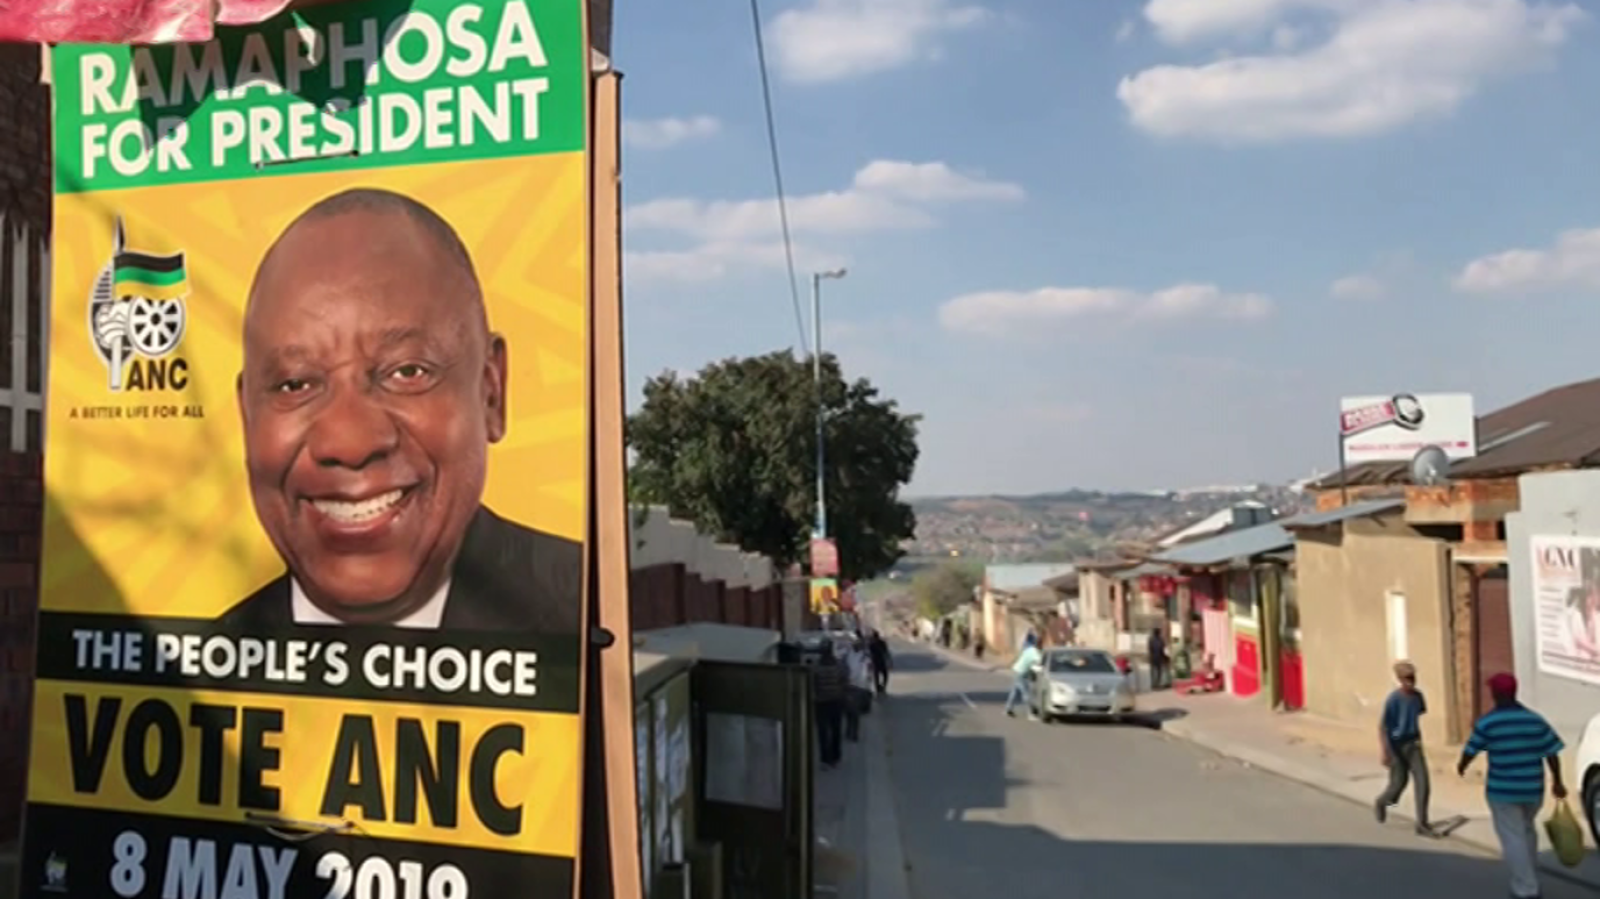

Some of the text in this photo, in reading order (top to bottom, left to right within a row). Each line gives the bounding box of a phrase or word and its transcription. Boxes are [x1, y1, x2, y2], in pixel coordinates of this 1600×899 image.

[79, 0, 548, 116] RAMAPHOSA
[82, 77, 549, 179] FOR PRESIDENT
[125, 357, 188, 391] ANC
[69, 405, 205, 419] A BETTER LIFE FOR ALL
[73, 629, 538, 695] THE PEOPLE'S CHOICE
[63, 693, 526, 837] VOTE ANC
[109, 830, 469, 899] 8 MAY 2019
